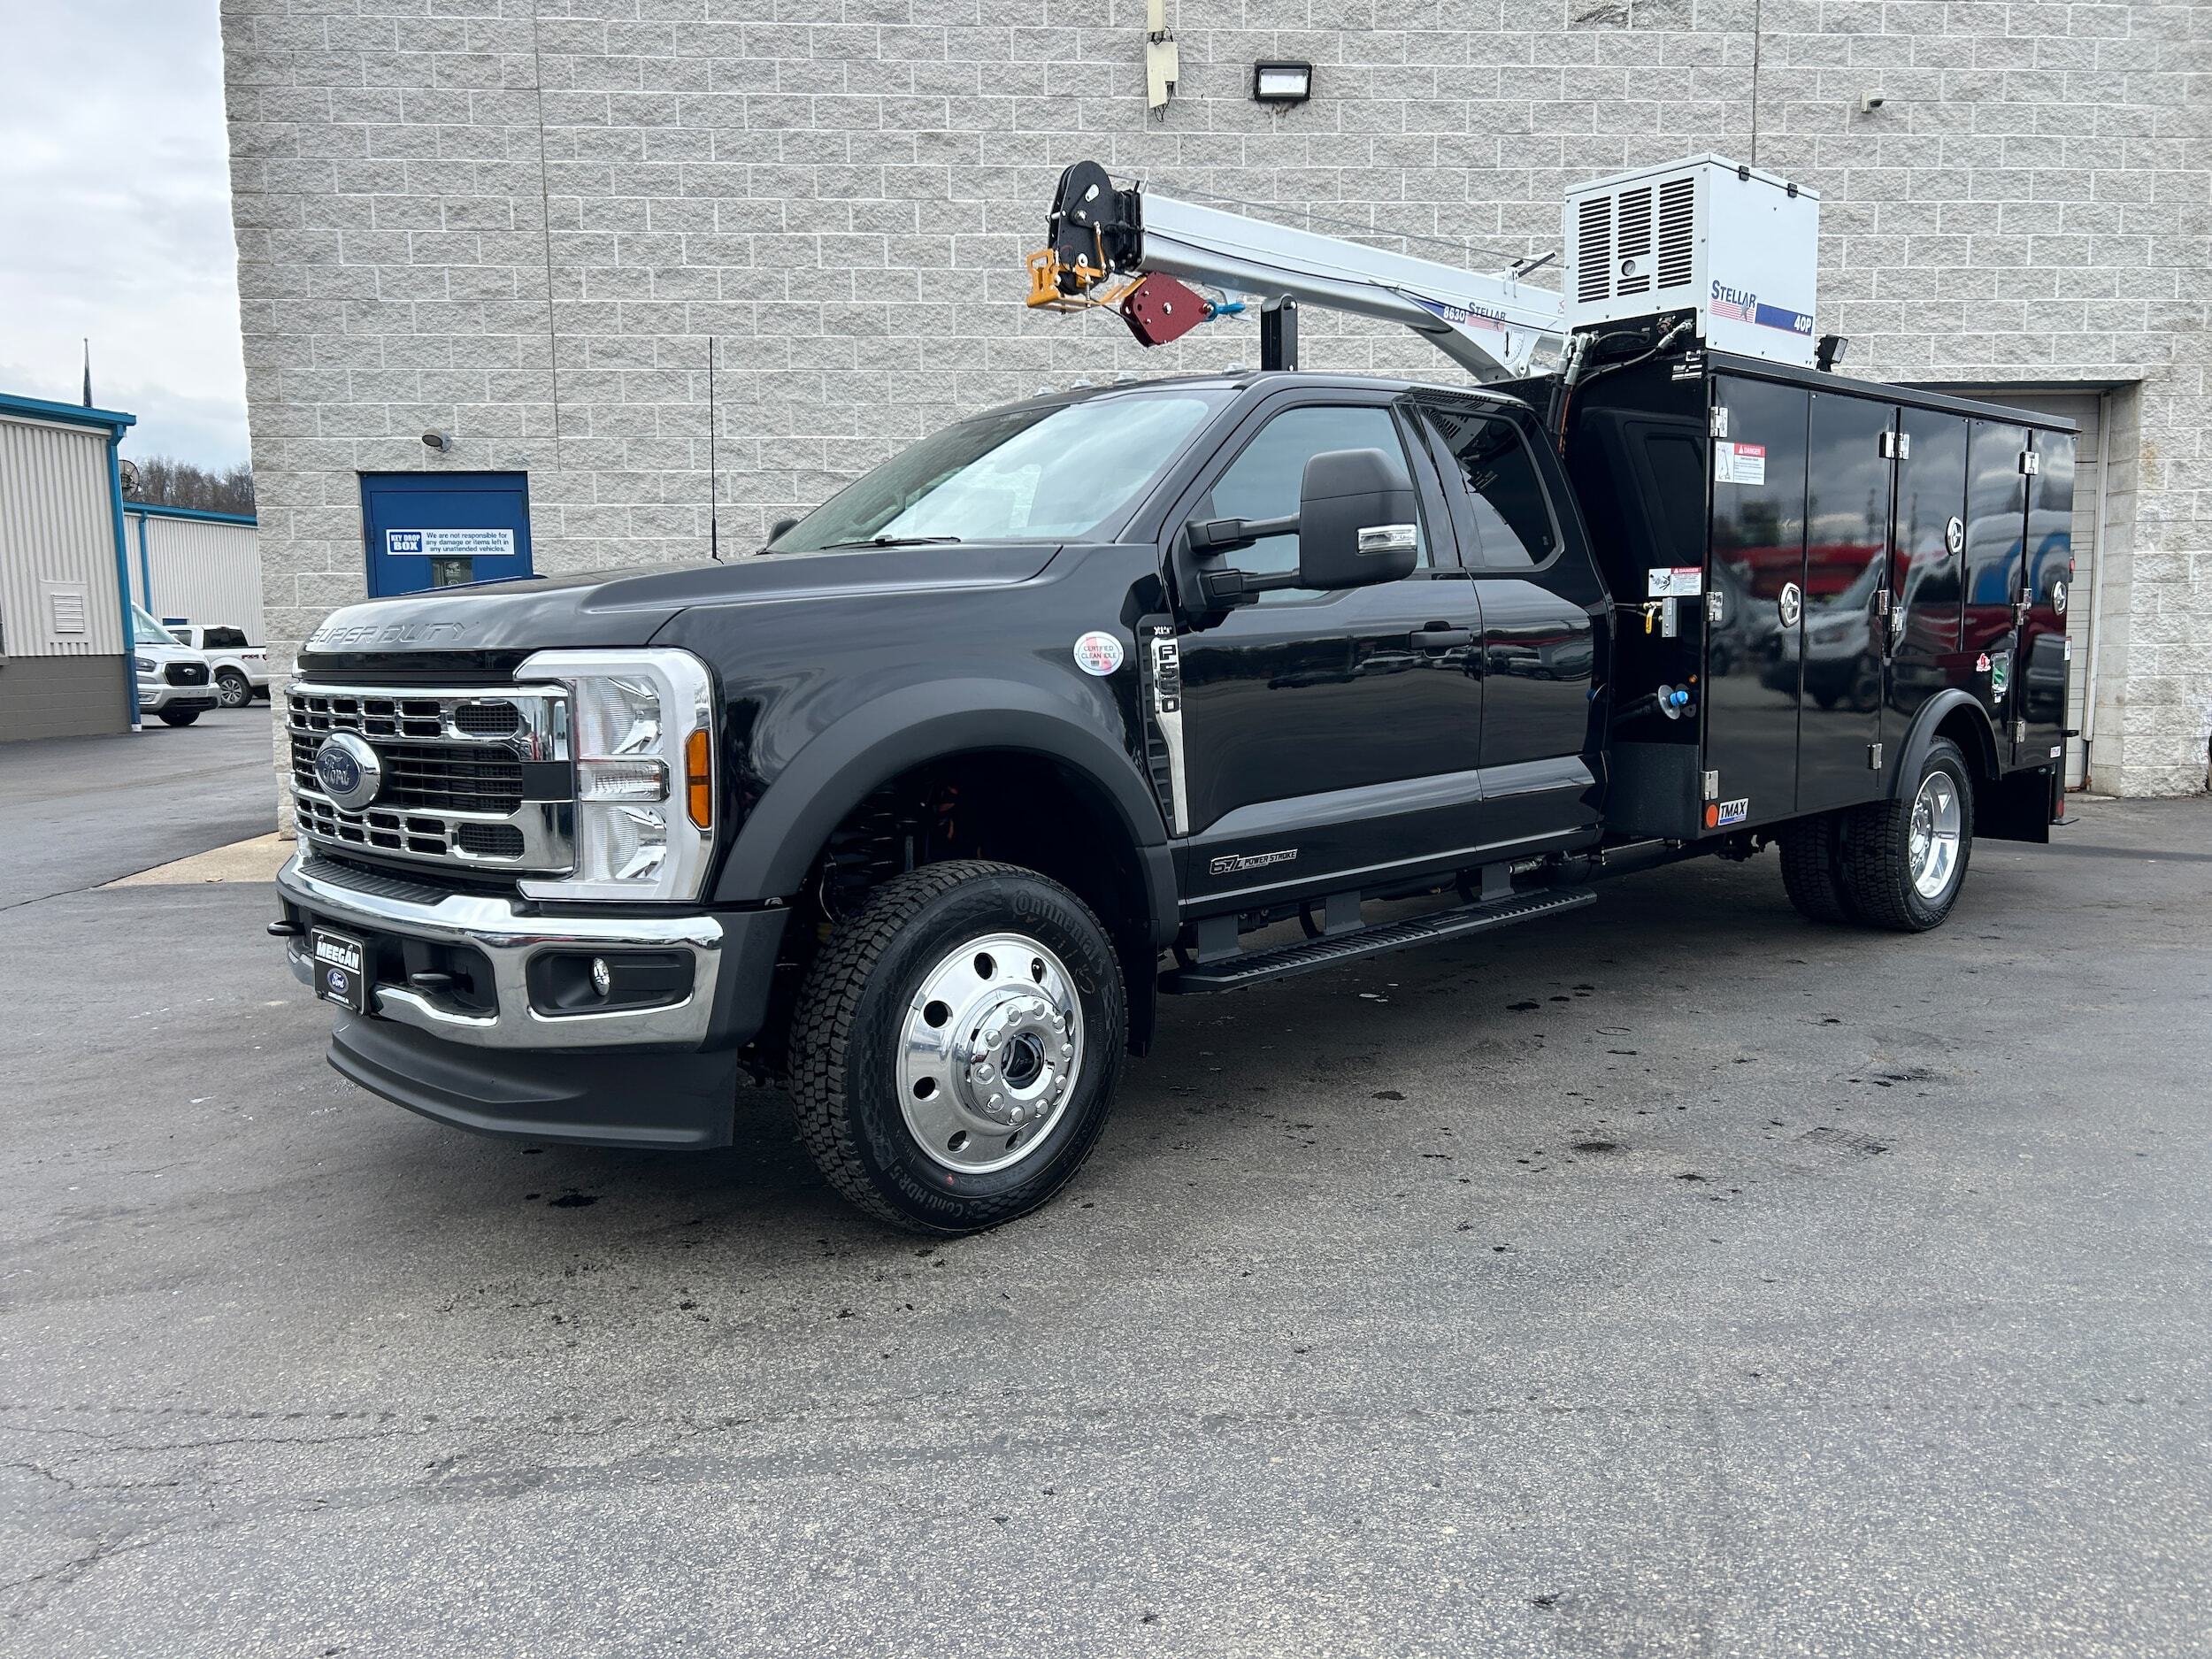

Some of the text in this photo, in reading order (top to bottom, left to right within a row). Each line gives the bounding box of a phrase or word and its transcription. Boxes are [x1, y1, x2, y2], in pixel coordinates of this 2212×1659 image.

[1711, 280, 1756, 308] STELLAR
[1443, 306, 1466, 321] 8630
[1469, 302, 1506, 320] STELLAR
[1793, 315, 1812, 333] 40P
[394, 541, 419, 550] BOX
[310, 622, 470, 644] SUPER DUTY
[322, 753, 350, 787] Ford
[1721, 802, 1746, 818] TMAX
[1244, 856, 1269, 867] POWER
[1270, 849, 1297, 862] STROKE
[1012, 888, 1100, 962] Continental
[317, 941, 359, 969] MEEGAN
